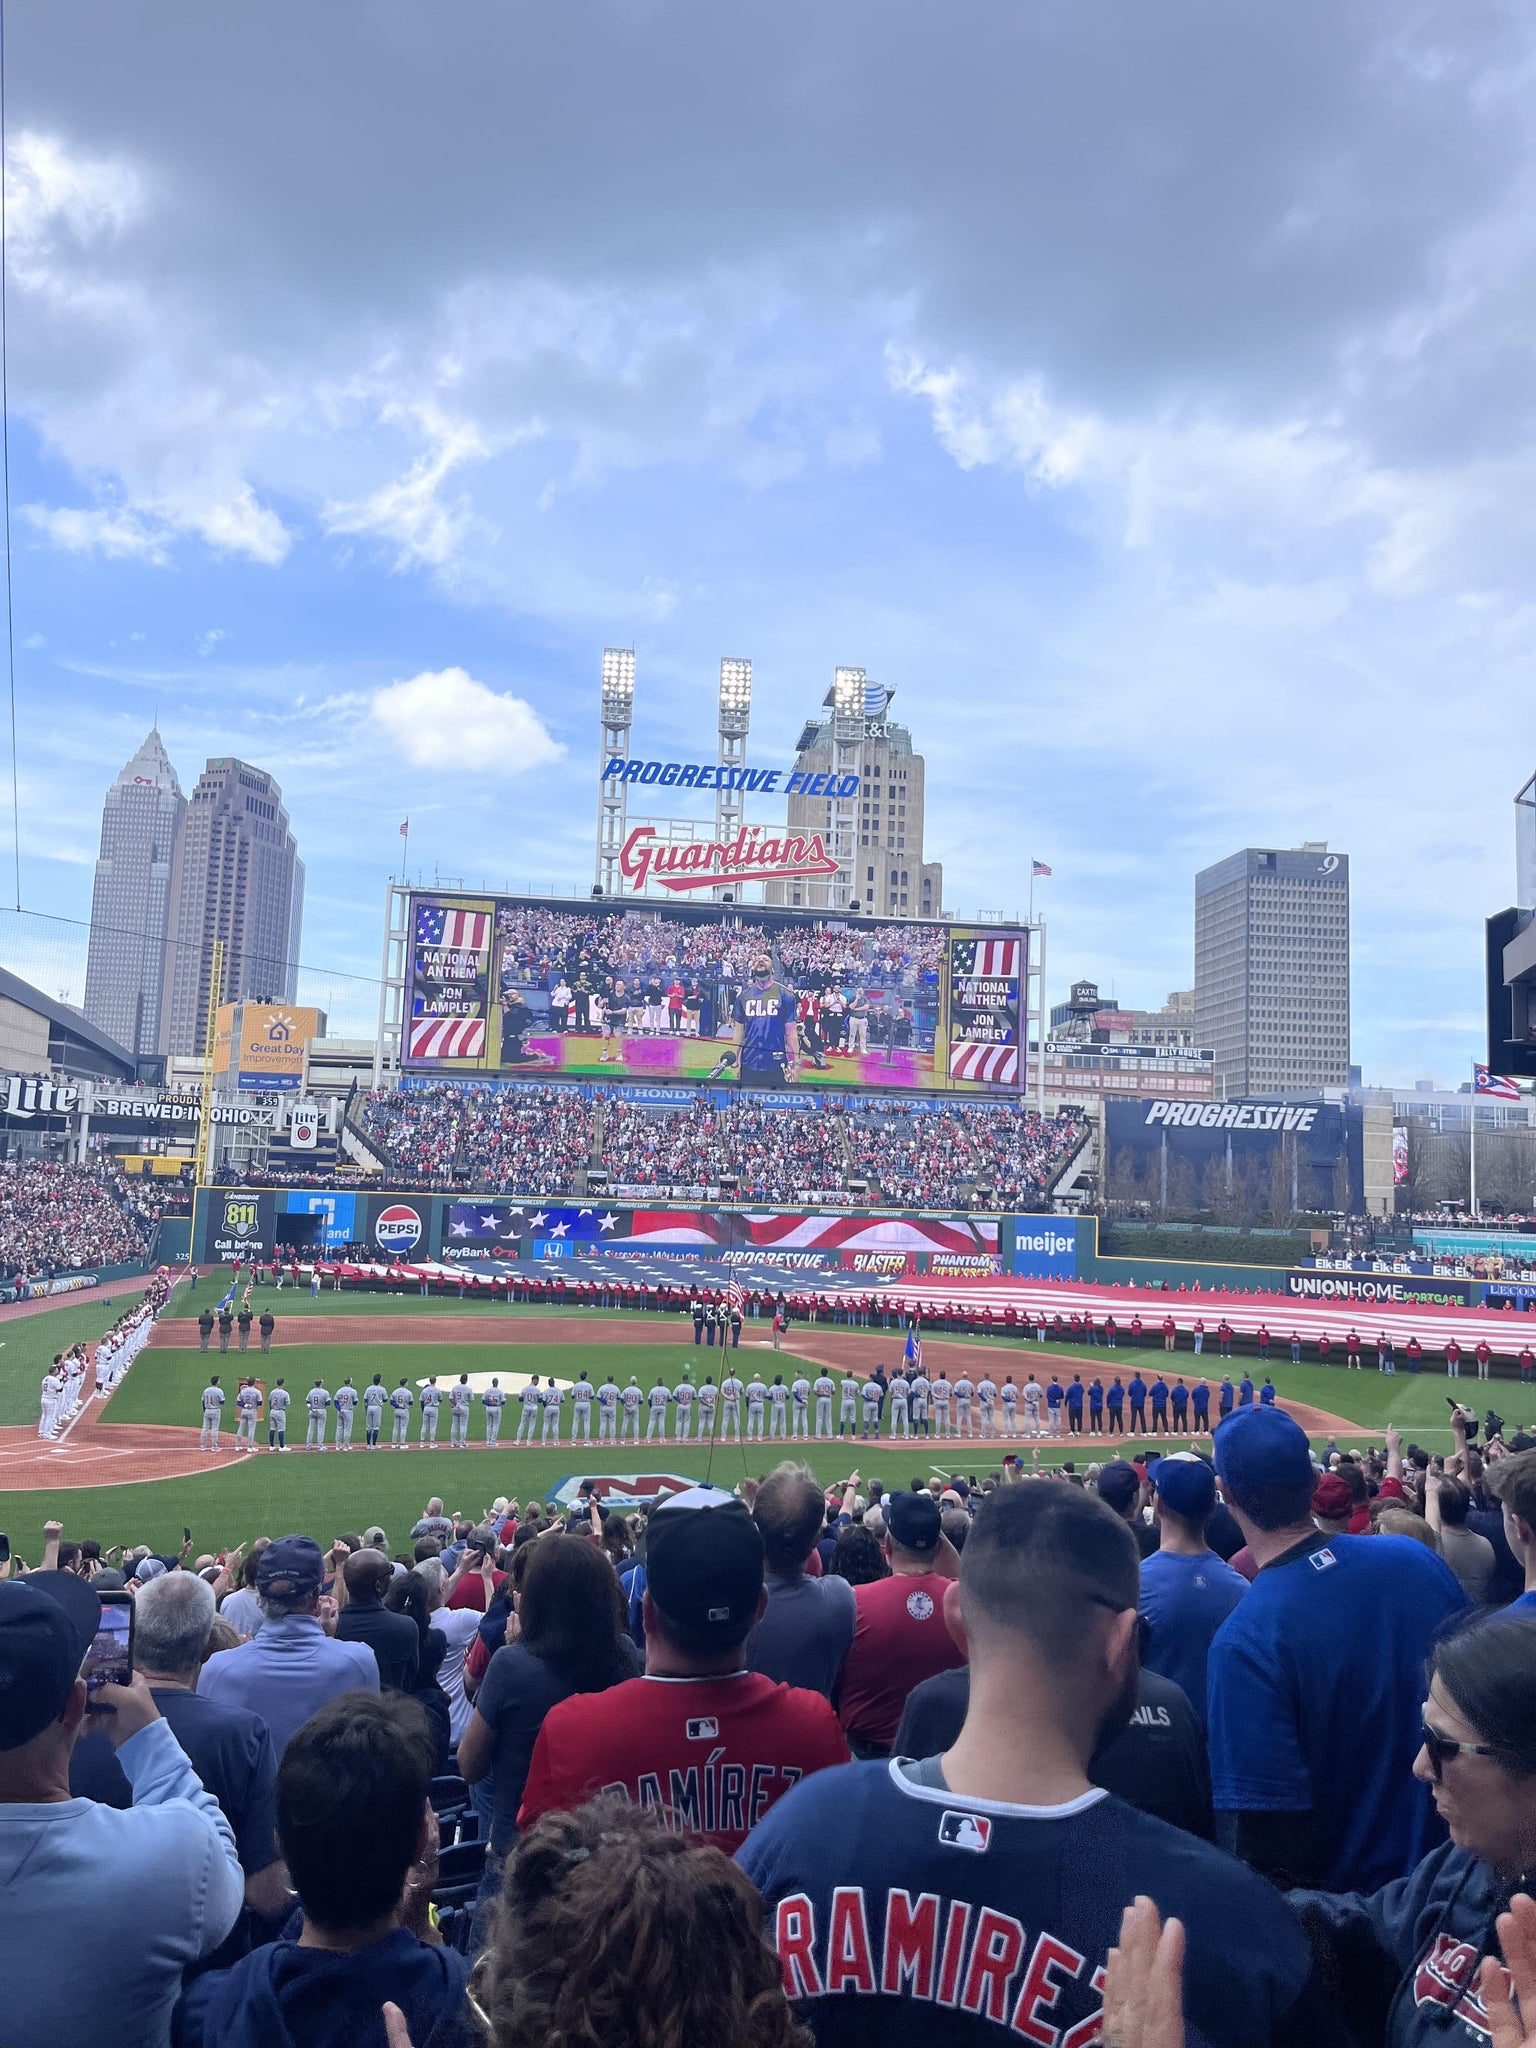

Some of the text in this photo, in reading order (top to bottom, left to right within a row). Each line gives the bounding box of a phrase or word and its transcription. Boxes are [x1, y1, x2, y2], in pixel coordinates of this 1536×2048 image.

[600, 758, 860, 798] PROGRESSIVE FIELD
[619, 826, 840, 893] Guardians
[1321, 855, 1339, 876] 9
[423, 951, 480, 967] NATIONAL
[426, 965, 476, 979] ANTHEM
[439, 987, 463, 1000] JON
[958, 981, 1011, 994] NATIONAL
[961, 994, 1007, 1007] ANTHEM
[423, 1001, 475, 1014] LAMPLEY
[745, 999, 779, 1017] CLE
[973, 1014, 994, 1026] JON
[959, 1026, 1008, 1041] LAMPLEY
[250, 1042, 305, 1056] Great Day
[1155, 1048, 1203, 1060] RALLY HOUSE
[243, 1053, 303, 1064] Improvemen
[425, 1080, 493, 1092] HONDA
[3, 1076, 78, 1119] Lite
[633, 1089, 698, 1100] HONDA
[753, 1093, 815, 1104] HONDA
[107, 1101, 183, 1119] BREWED
[211, 1107, 250, 1123] OHIO
[295, 1112, 316, 1125] Lite
[1145, 1101, 1319, 1132] PROGRESSIVE
[227, 1203, 255, 1224] 811
[968, 1213, 1004, 1221] PROGRESSIVE
[378, 1223, 419, 1235] PEPSI
[214, 1239, 231, 1249] Call
[1016, 1231, 1075, 1256] meijer
[175, 1252, 189, 1260] 325
[442, 1245, 490, 1260] KeyBank
[853, 1254, 906, 1273] BLASTER
[932, 1255, 990, 1267] PHANTOM
[1403, 1291, 1464, 1306] MORTGAGE
[206, 1395, 213, 1404] 11
[313, 1396, 319, 1405] 8
[371, 1393, 377, 1401] 7
[397, 1395, 403, 1404] 6
[457, 1391, 462, 1400] 9
[577, 1390, 588, 1399] 84
[1129, 1705, 1171, 1726] AILS
